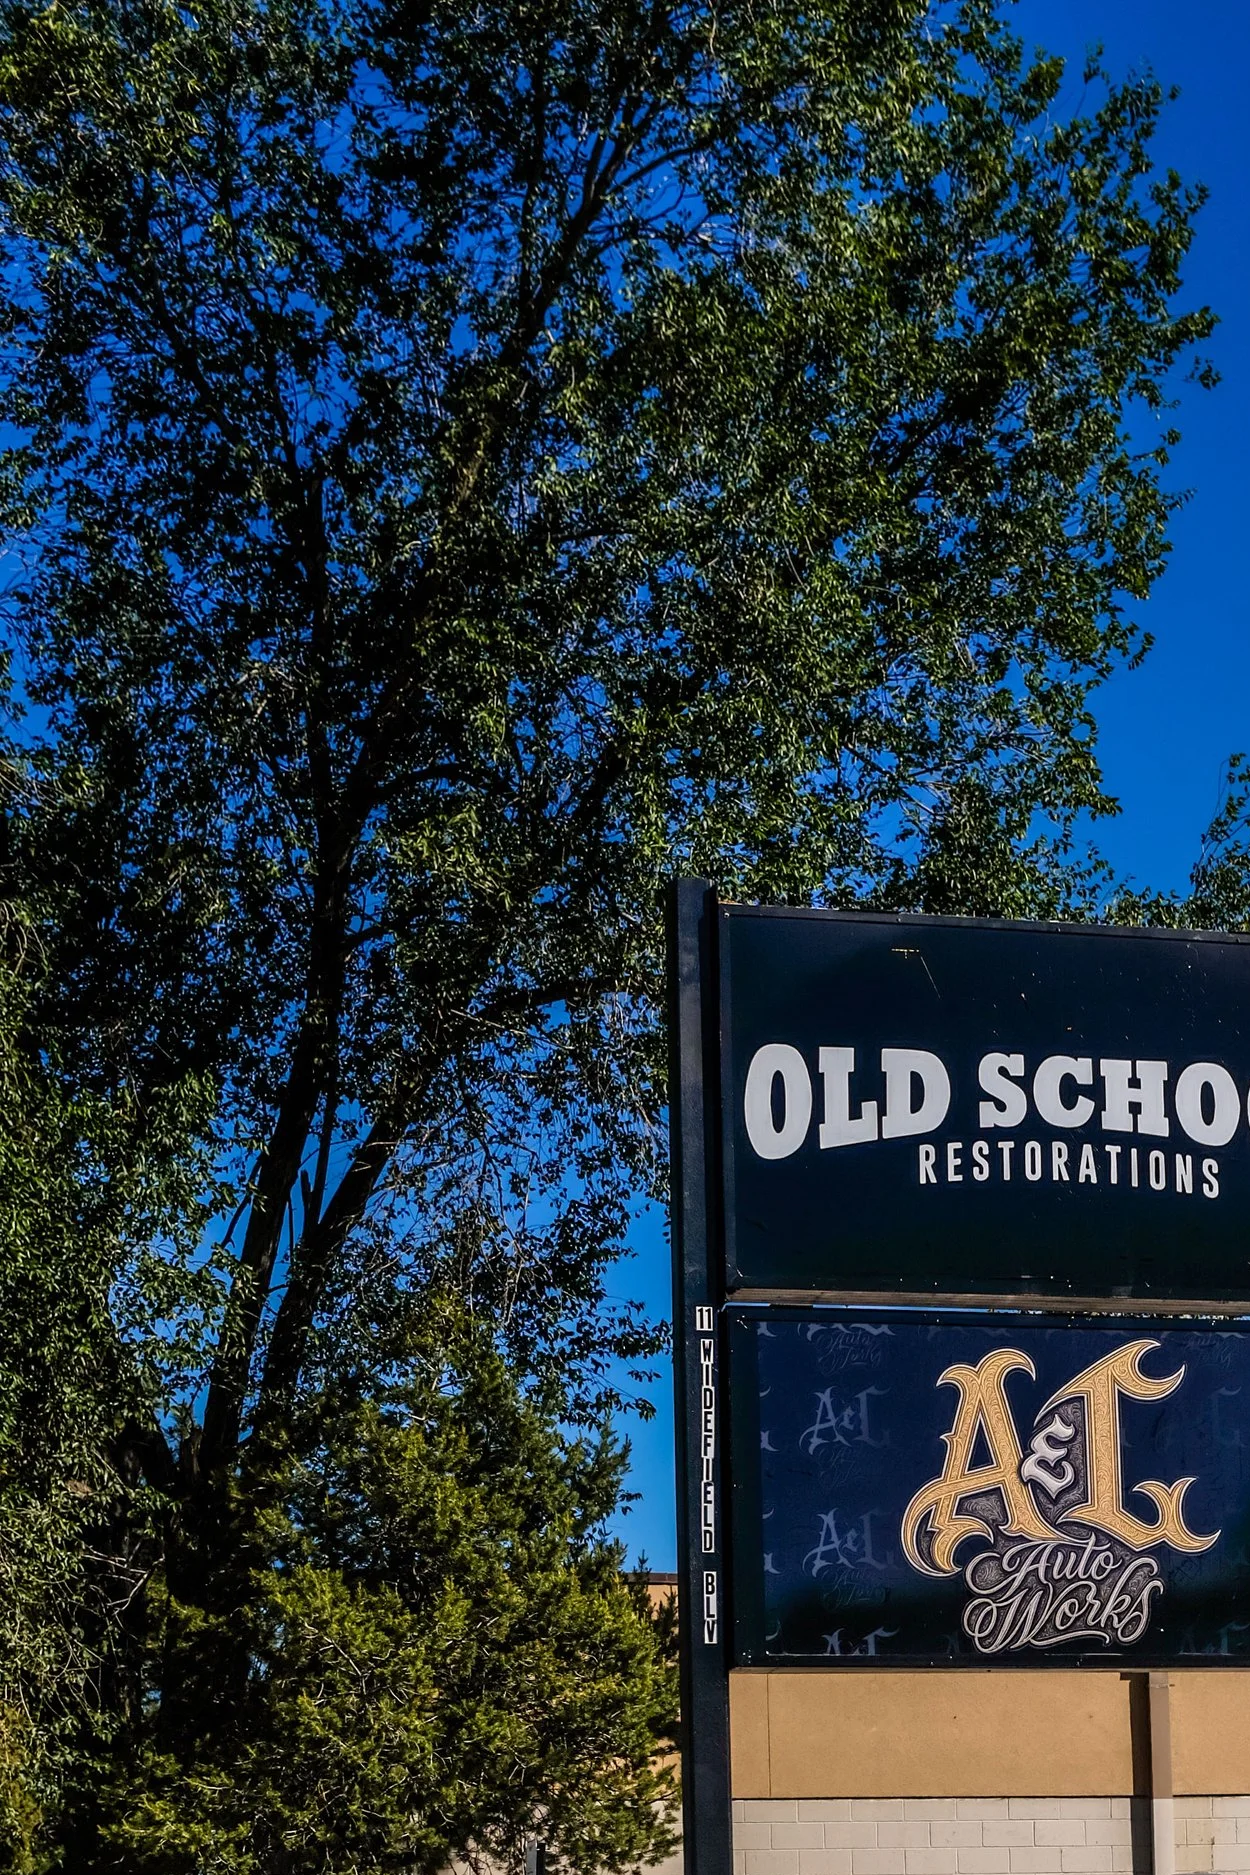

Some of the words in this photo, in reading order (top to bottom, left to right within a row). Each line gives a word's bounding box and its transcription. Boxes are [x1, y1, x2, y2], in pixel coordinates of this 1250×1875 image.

[745, 1043, 951, 1160] OLD
[918, 1140, 1219, 1199] RESTORATIONS
[697, 1309, 712, 1329] 11
[702, 1340, 714, 1551] WIDEFIELD
[966, 1532, 1122, 1601] Auto
[705, 1574, 716, 1643] BLV
[962, 1557, 1164, 1654] Works
